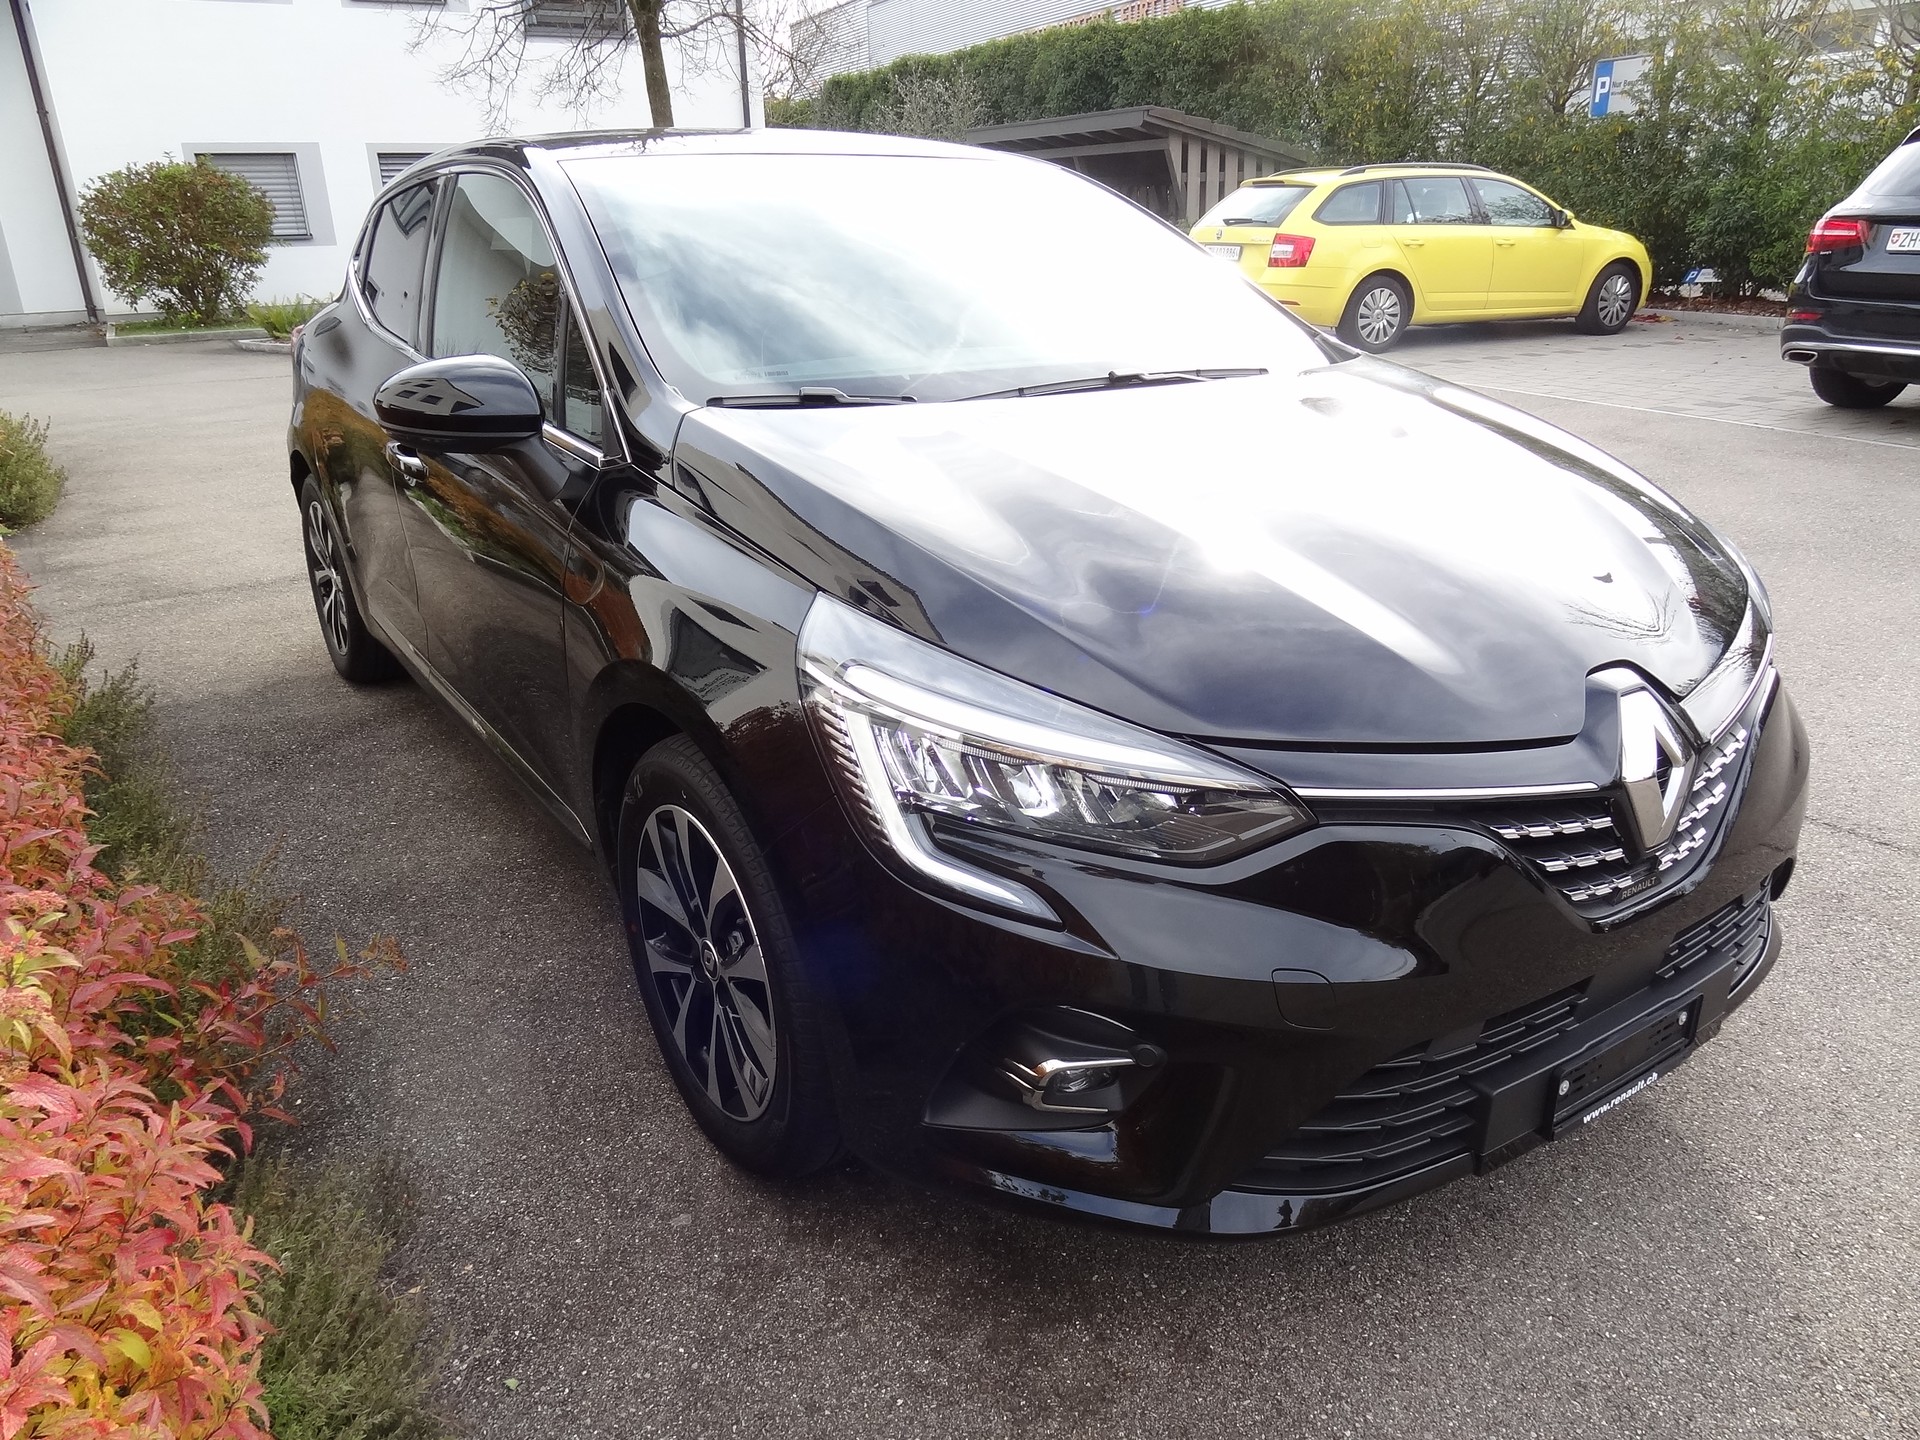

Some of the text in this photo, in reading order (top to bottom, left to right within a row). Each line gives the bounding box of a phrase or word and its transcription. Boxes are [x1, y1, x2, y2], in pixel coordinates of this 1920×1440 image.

[1594, 76, 1610, 103] P
[1685, 271, 1698, 282] P
[1621, 876, 1656, 900] RENAULT
[1583, 1072, 1658, 1124] www.renault.ch
